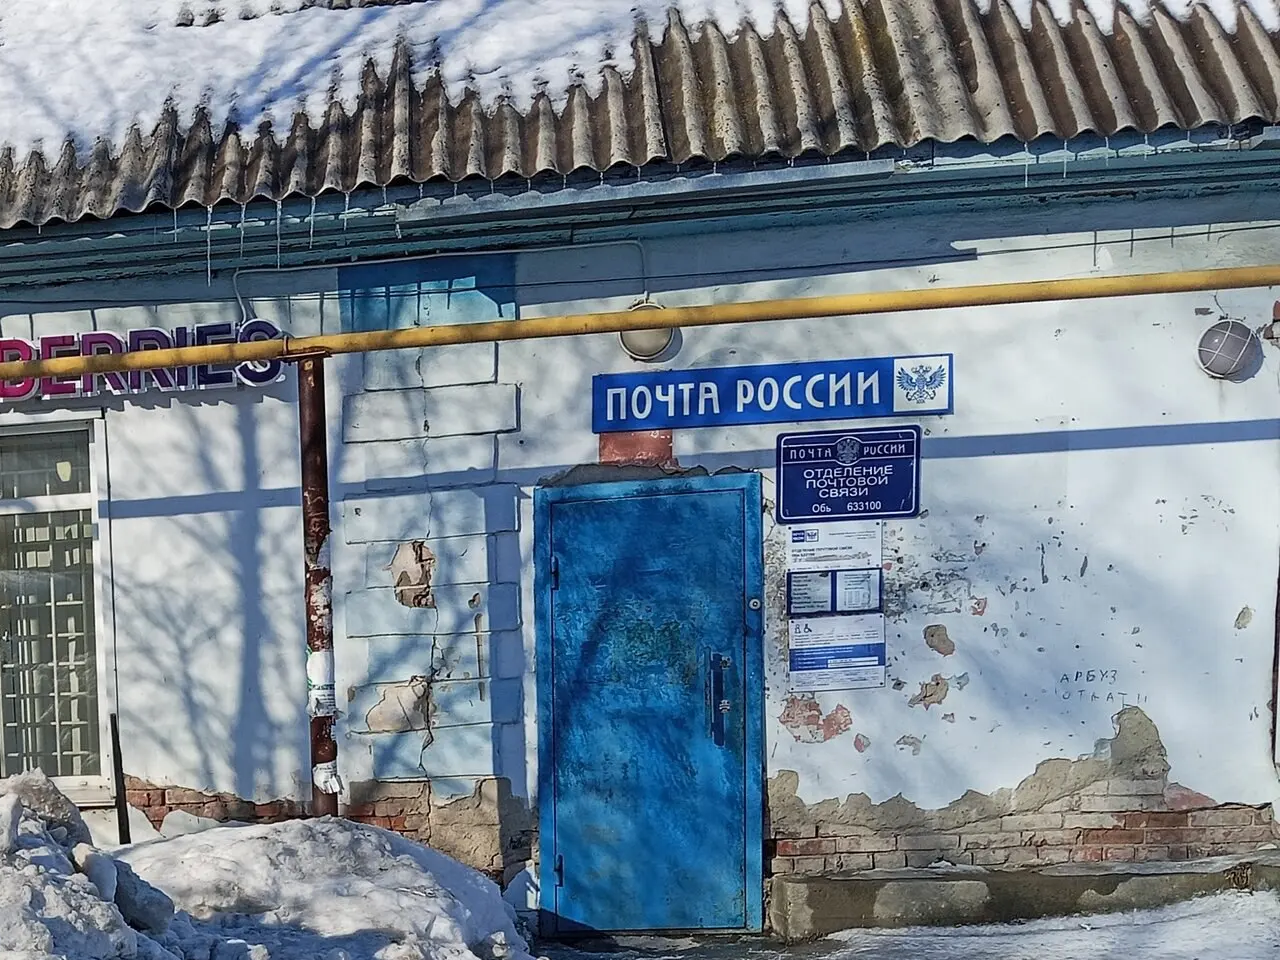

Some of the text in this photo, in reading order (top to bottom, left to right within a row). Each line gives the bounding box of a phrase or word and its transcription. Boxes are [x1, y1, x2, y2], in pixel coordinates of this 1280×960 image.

[606, 370, 880, 421] ПОЧТА РОССИИ
[790, 443, 906, 459] ПОЧТА РОССИИ
[803, 464, 894, 479] ОТДЕЛЕНИЕ
[805, 474, 889, 489] ПОЧТОВОЙ
[818, 487, 869, 499] СВЯЗИ
[811, 500, 882, 513] Обь 633100
